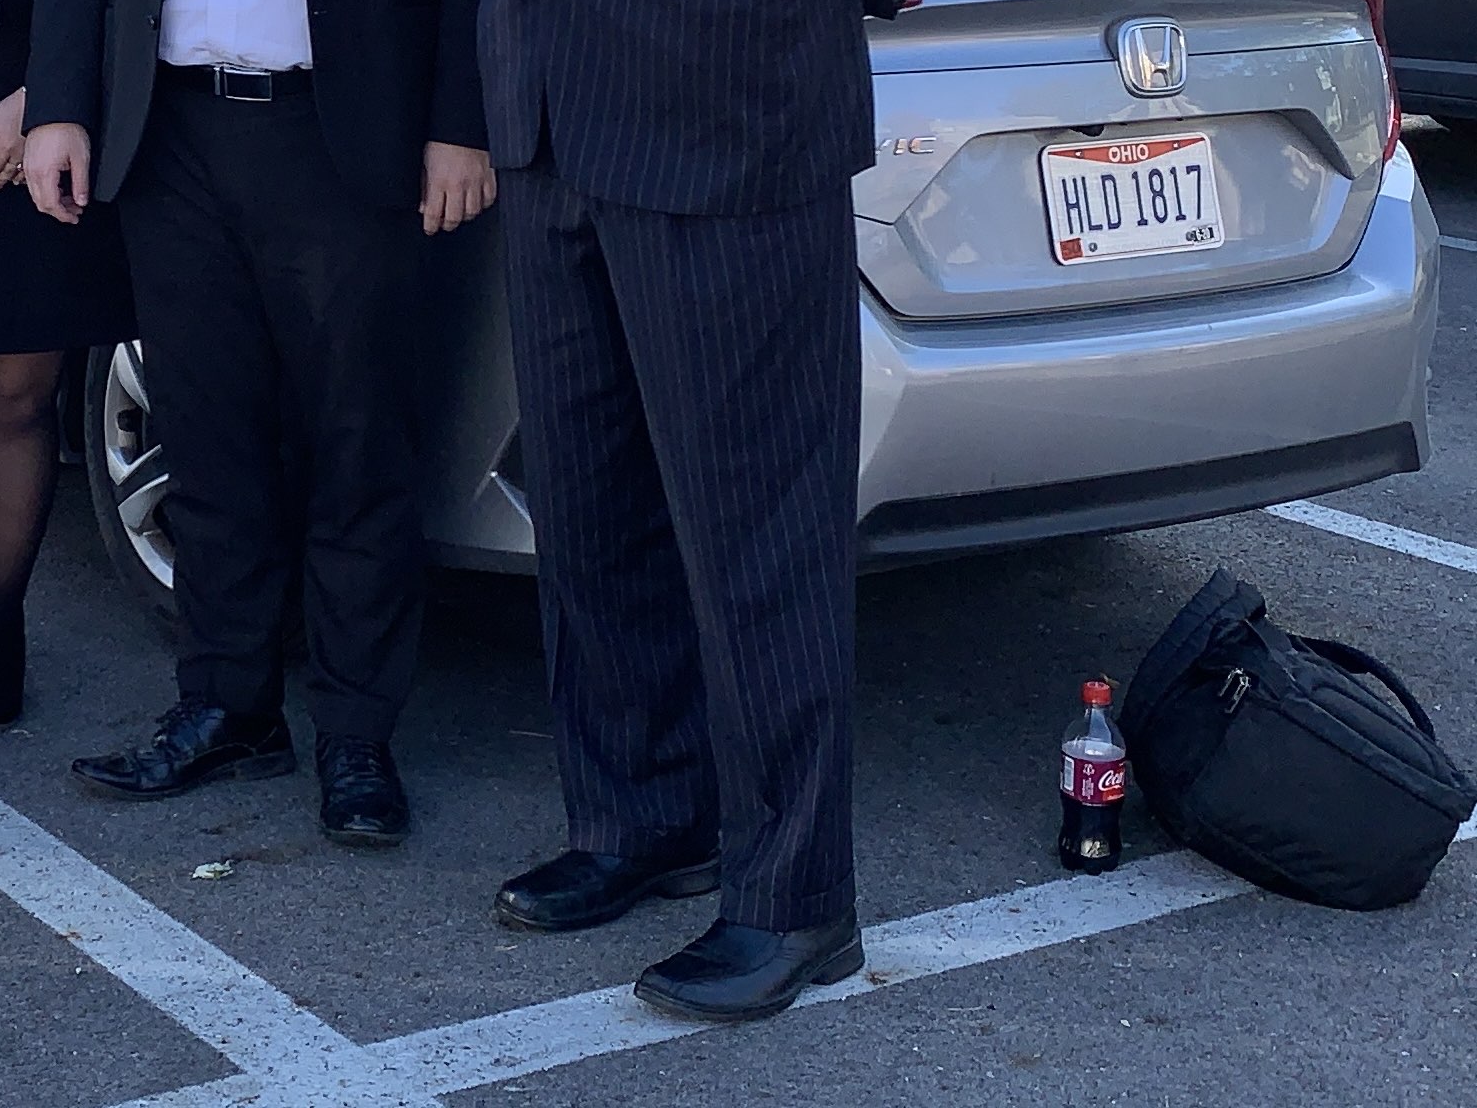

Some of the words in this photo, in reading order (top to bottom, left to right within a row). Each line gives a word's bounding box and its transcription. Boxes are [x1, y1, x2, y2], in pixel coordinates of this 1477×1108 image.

[1108, 143, 1149, 163] OHIO
[1061, 173, 1122, 235] HLD
[1131, 164, 1201, 226] 1817
